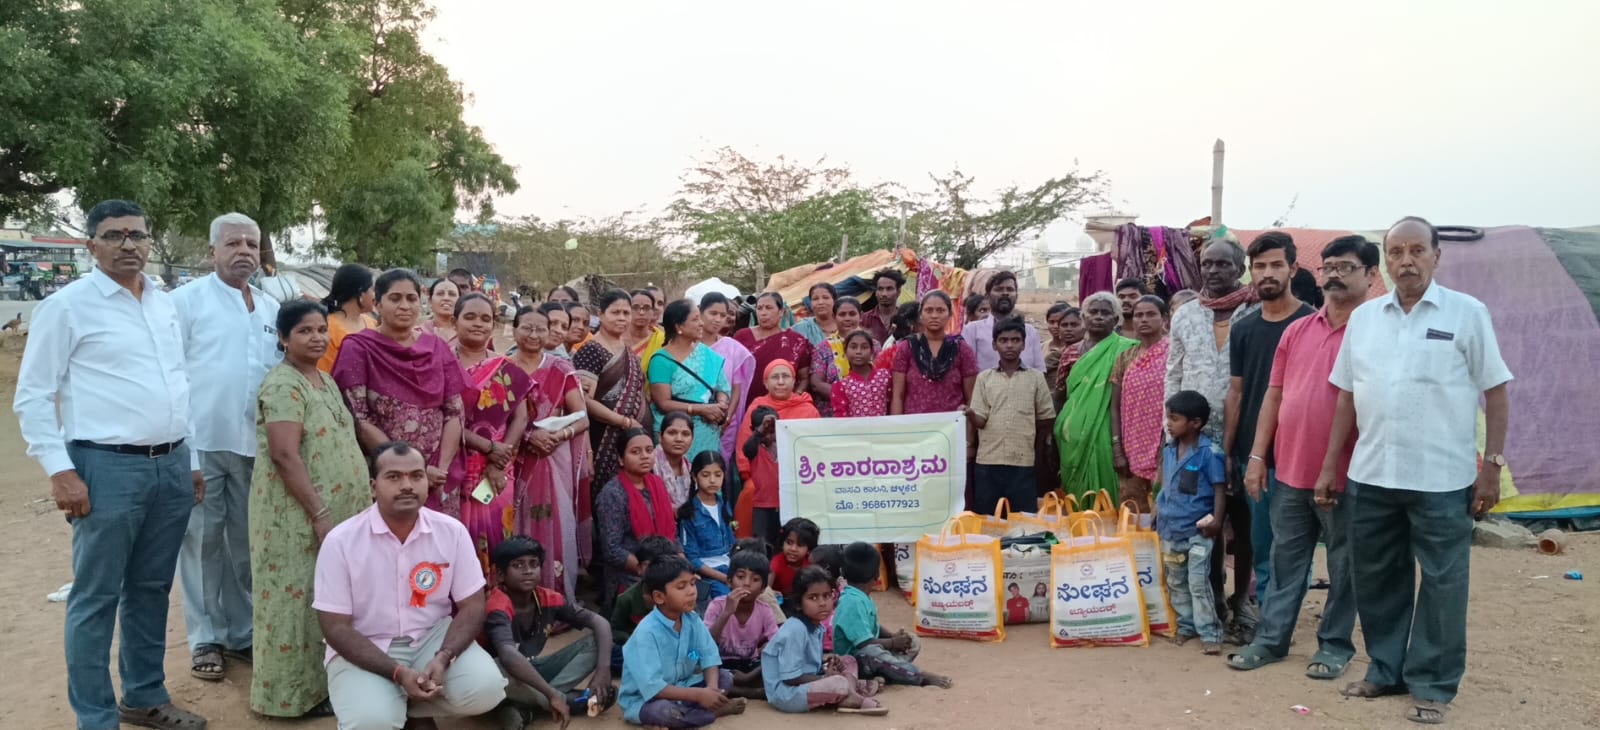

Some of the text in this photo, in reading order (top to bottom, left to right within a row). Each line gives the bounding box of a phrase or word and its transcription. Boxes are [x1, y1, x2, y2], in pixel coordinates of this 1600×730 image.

[798, 454, 948, 484] ಶ್ರೀ ಶಾರದಾಶ್ರಮ
[862, 499, 920, 510] 9686177923
[922, 575, 988, 598] ಮೇಘನ
[1057, 575, 1130, 603] ಮೇಘನ
